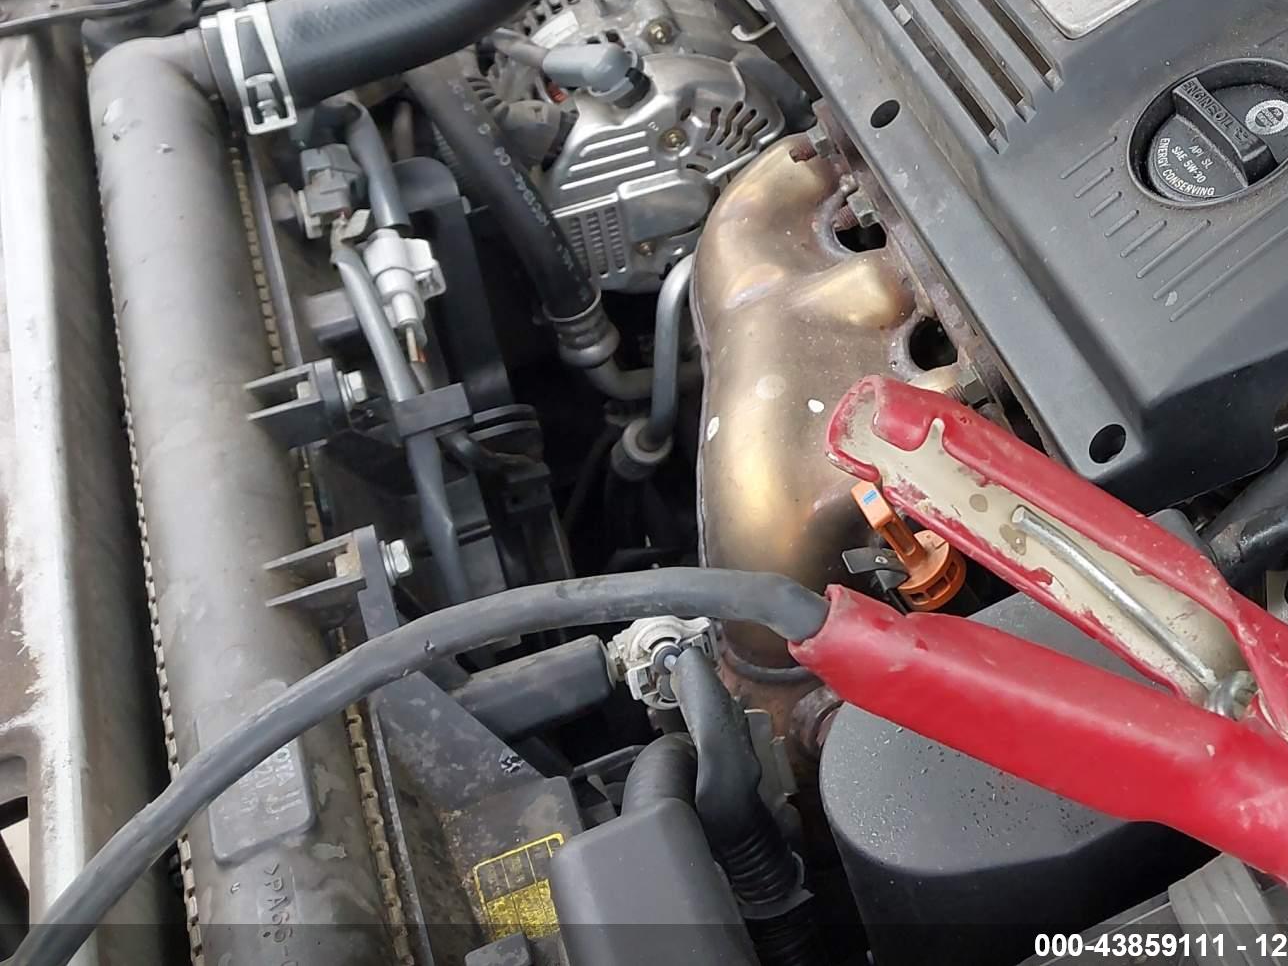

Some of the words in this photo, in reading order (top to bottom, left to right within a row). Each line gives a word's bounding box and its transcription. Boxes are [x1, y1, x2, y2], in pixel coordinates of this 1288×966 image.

[1181, 81, 1216, 116] ENGINE
[1214, 109, 1236, 129] OIL
[1157, 138, 1170, 170] ENERGY
[1171, 146, 1187, 162] SAE
[1183, 160, 1207, 183] 5W-30
[1188, 145, 1205, 158] API
[1201, 158, 1214, 170] SL
[1162, 169, 1215, 197] CONSERVING
